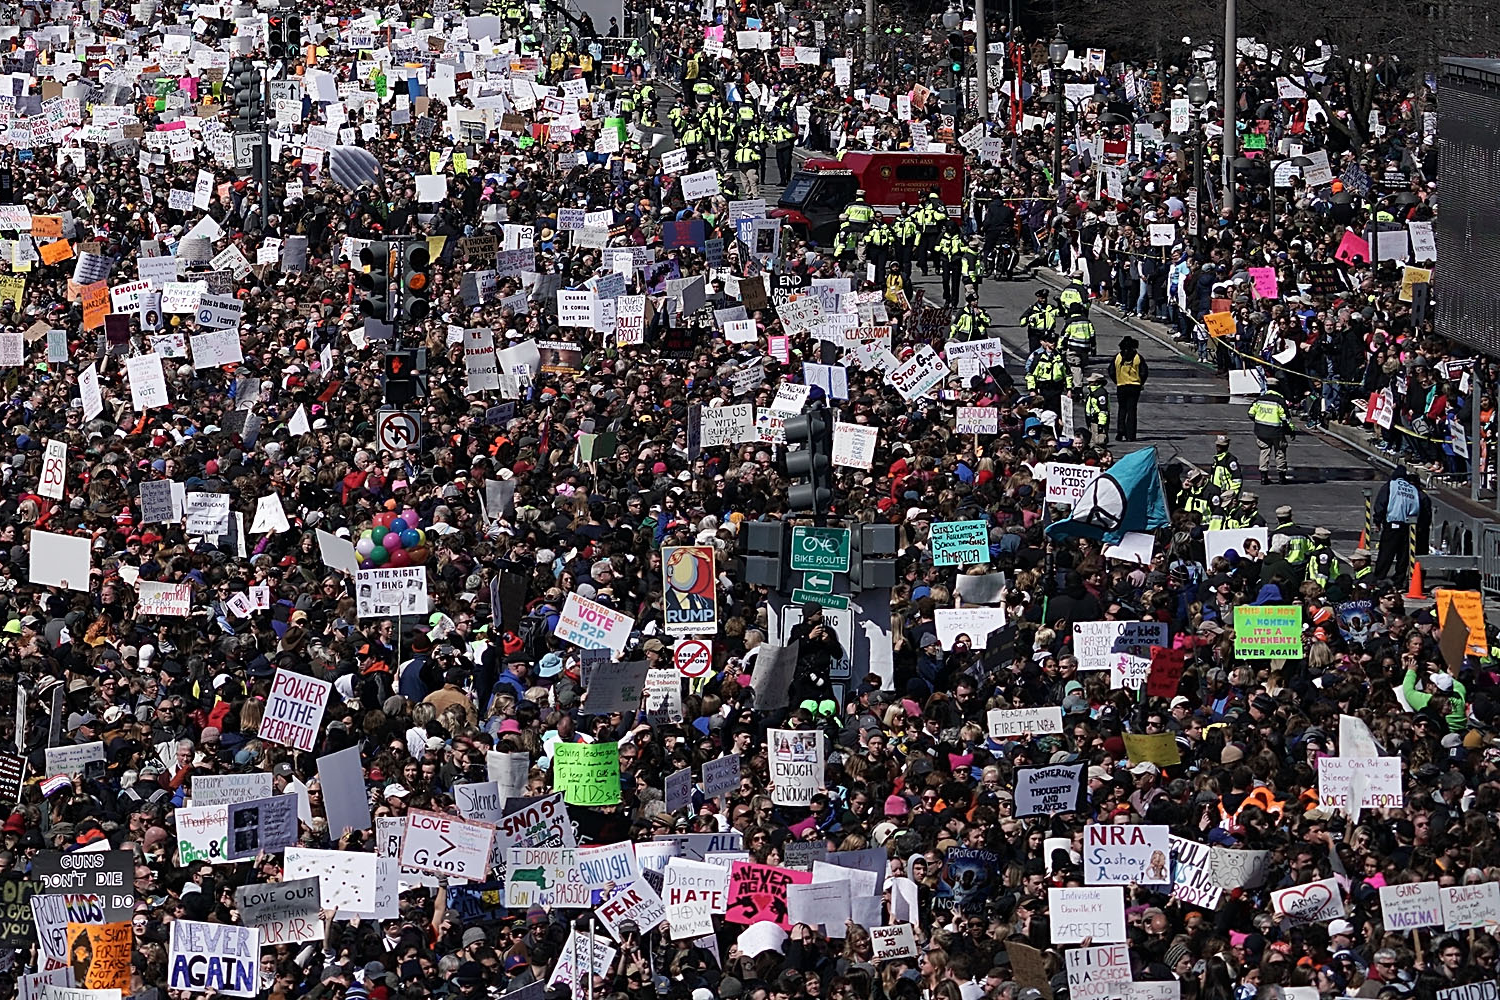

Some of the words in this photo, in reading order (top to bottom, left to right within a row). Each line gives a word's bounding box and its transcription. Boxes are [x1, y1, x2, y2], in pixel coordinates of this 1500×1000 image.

[779, 275, 802, 287] END
[114, 282, 149, 296] ENOUGH
[774, 286, 806, 297] POLICE
[129, 293, 139, 301] IS
[200, 298, 210, 307] This
[211, 301, 217, 309] is
[218, 302, 227, 310] the
[227, 303, 242, 313] only
[471, 331, 482, 340] WE
[845, 326, 890, 340] CLASSROOM
[465, 346, 494, 356] DEMAND
[468, 366, 497, 375] CHANGE
[891, 363, 917, 386] STOP
[701, 408, 724, 420] ARM
[732, 406, 748, 417] US
[714, 418, 738, 428] WITH
[707, 425, 746, 437] SUPPORT
[1053, 466, 1094, 478] PROTECT
[1060, 477, 1086, 488] KIDS
[1049, 486, 1068, 496] NOT
[794, 554, 814, 563] BIKE
[816, 555, 846, 565] ROUTE
[941, 549, 980, 564] AMERICA
[800, 593, 825, 604] Nationals
[826, 597, 840, 606] Park
[572, 594, 609, 617] REGISTER
[614, 612, 625, 624] TO
[666, 609, 715, 623] RUMP
[1237, 607, 1260, 616] THIS
[1264, 607, 1273, 616] IS
[1277, 607, 1296, 616] NOT
[577, 605, 614, 632] VOTE
[1245, 618, 1251, 626] A
[1257, 618, 1296, 627] MOMENT
[581, 621, 606, 640] P2P
[666, 624, 715, 634] RumpRump.com
[1253, 627, 1272, 636] IT'S
[1275, 627, 1282, 636] A
[1240, 636, 1297, 645] MOVEMENT!
[1235, 648, 1265, 657] NEVER
[1270, 648, 1298, 657] AGAIN
[272, 673, 327, 707] POWER
[272, 697, 288, 718] TO
[289, 699, 316, 726] THE
[261, 716, 313, 751] PEACEFUL
[994, 722, 1015, 735] FIRE
[1015, 720, 1035, 732] THE
[1036, 720, 1056, 731] NRA
[1029, 768, 1076, 784] ANSWERING
[1030, 784, 1072, 797] THOUGHTS
[1042, 795, 1058, 803] AND
[1032, 801, 1068, 813] PRAYERS
[411, 815, 450, 834] LOVE
[1090, 826, 1151, 847] NRA,
[60, 854, 104, 869] GUNS
[413, 848, 466, 873] Guns
[1088, 848, 1145, 870] Sashay
[41, 870, 86, 889] DON'T
[95, 871, 123, 886] DIE
[667, 867, 715, 887] Disarm
[732, 865, 794, 884] #NEVER
[1096, 866, 1145, 883] Away!
[243, 891, 276, 908] LOVE
[284, 886, 314, 901] OUR
[739, 881, 788, 899] AGAIN
[601, 889, 643, 922] FEAR
[670, 888, 722, 910] HATE
[255, 910, 278, 921] MORE
[282, 908, 308, 920] THAN
[3, 922, 29, 939] you
[873, 927, 903, 939] ENOUGH
[1057, 922, 1112, 938] #RESIST
[173, 920, 251, 957] NEVER
[884, 938, 896, 946] IS
[877, 946, 910, 959] ENOUGH
[171, 954, 254, 991] AGAIN
